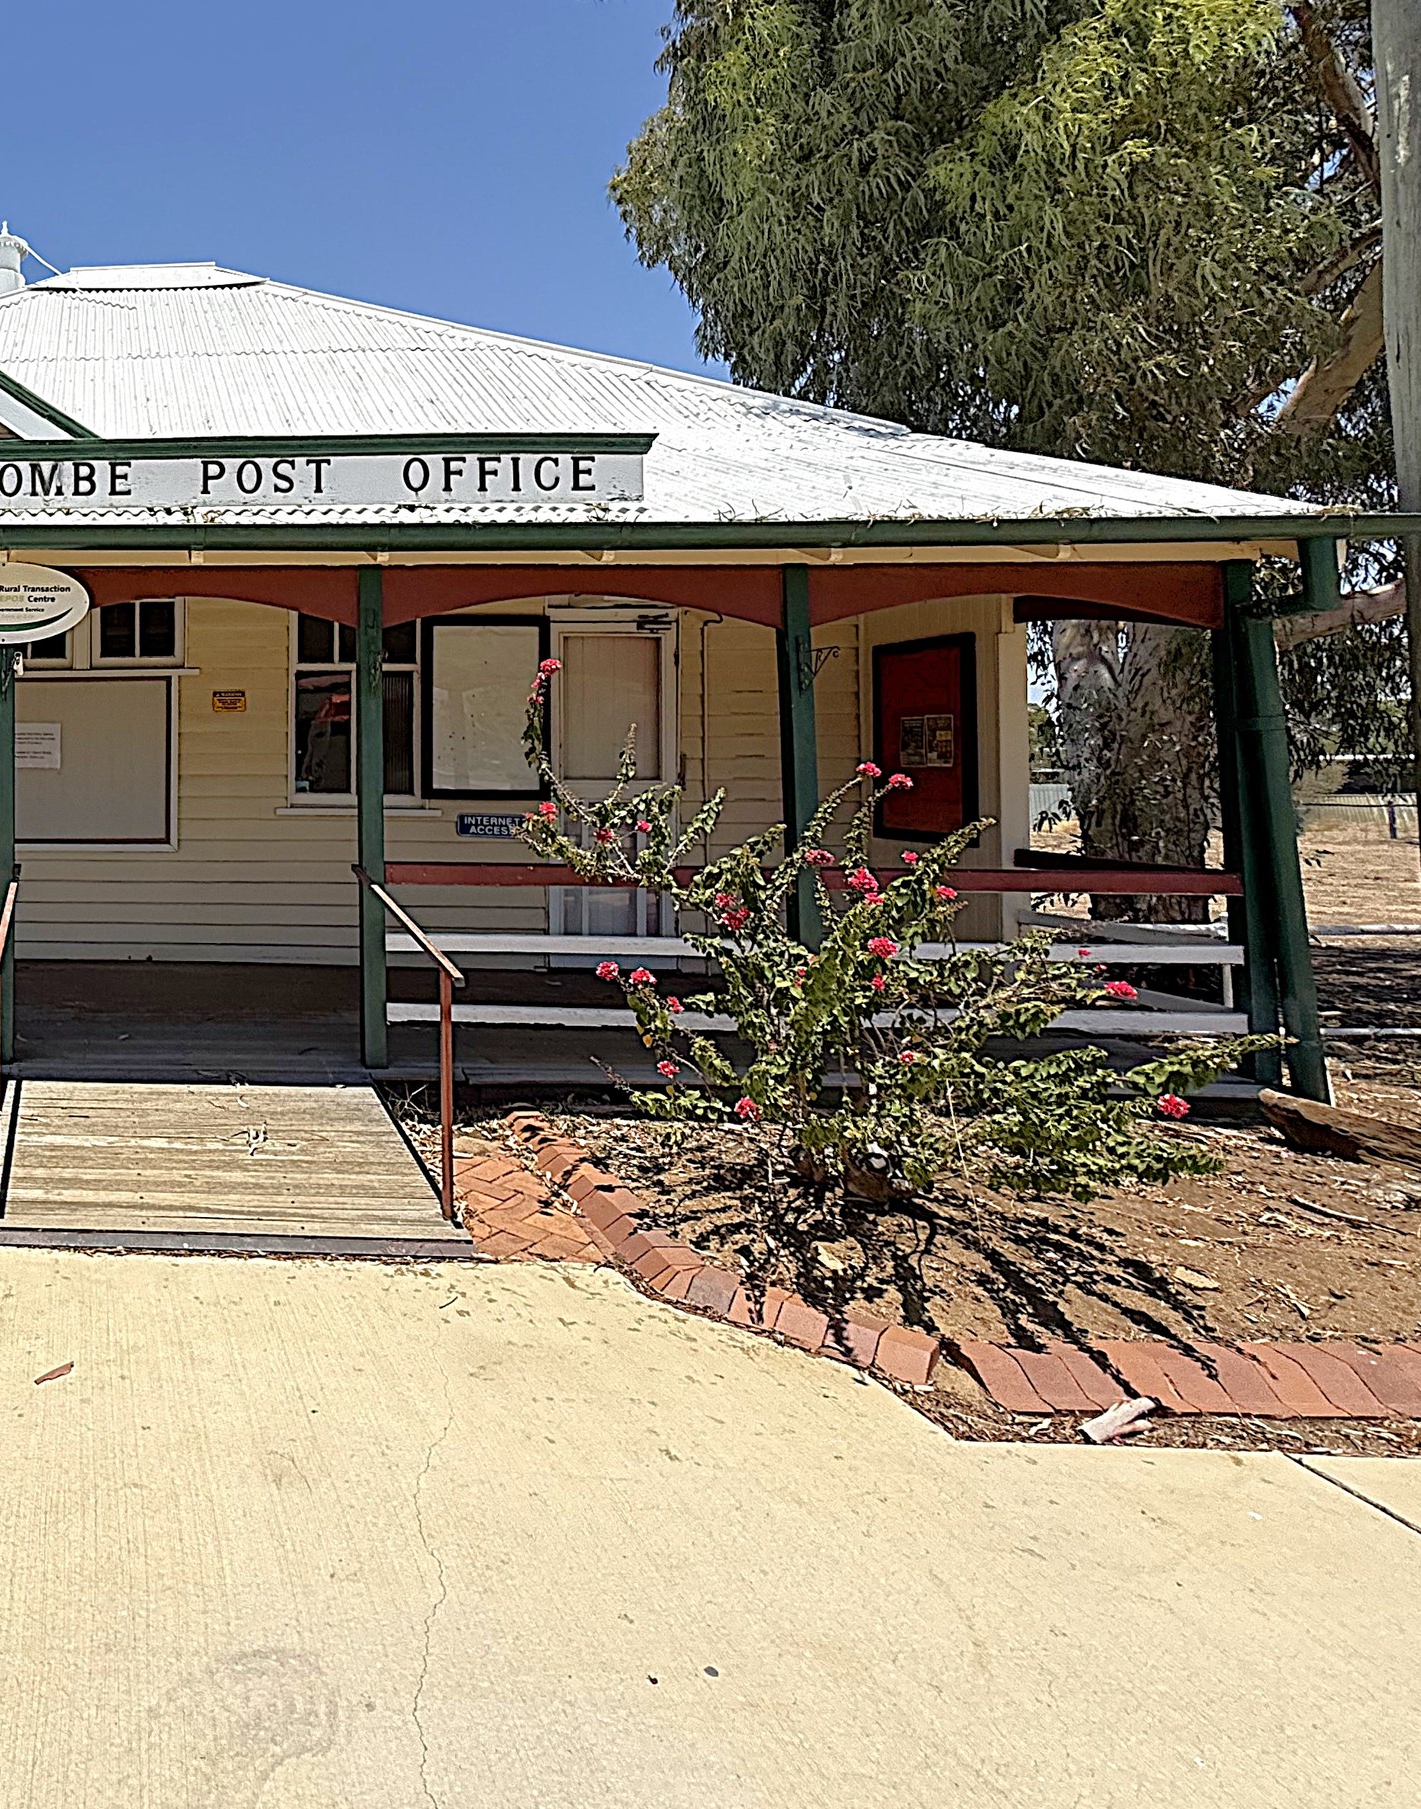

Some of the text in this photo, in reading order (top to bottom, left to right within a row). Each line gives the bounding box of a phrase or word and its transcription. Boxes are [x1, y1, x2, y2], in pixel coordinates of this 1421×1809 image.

[200, 458, 332, 495] POST
[402, 455, 597, 493] OFFICE
[22, 584, 71, 593] Transaction
[27, 595, 56, 603] Centre
[464, 816, 520, 826] INTERNET
